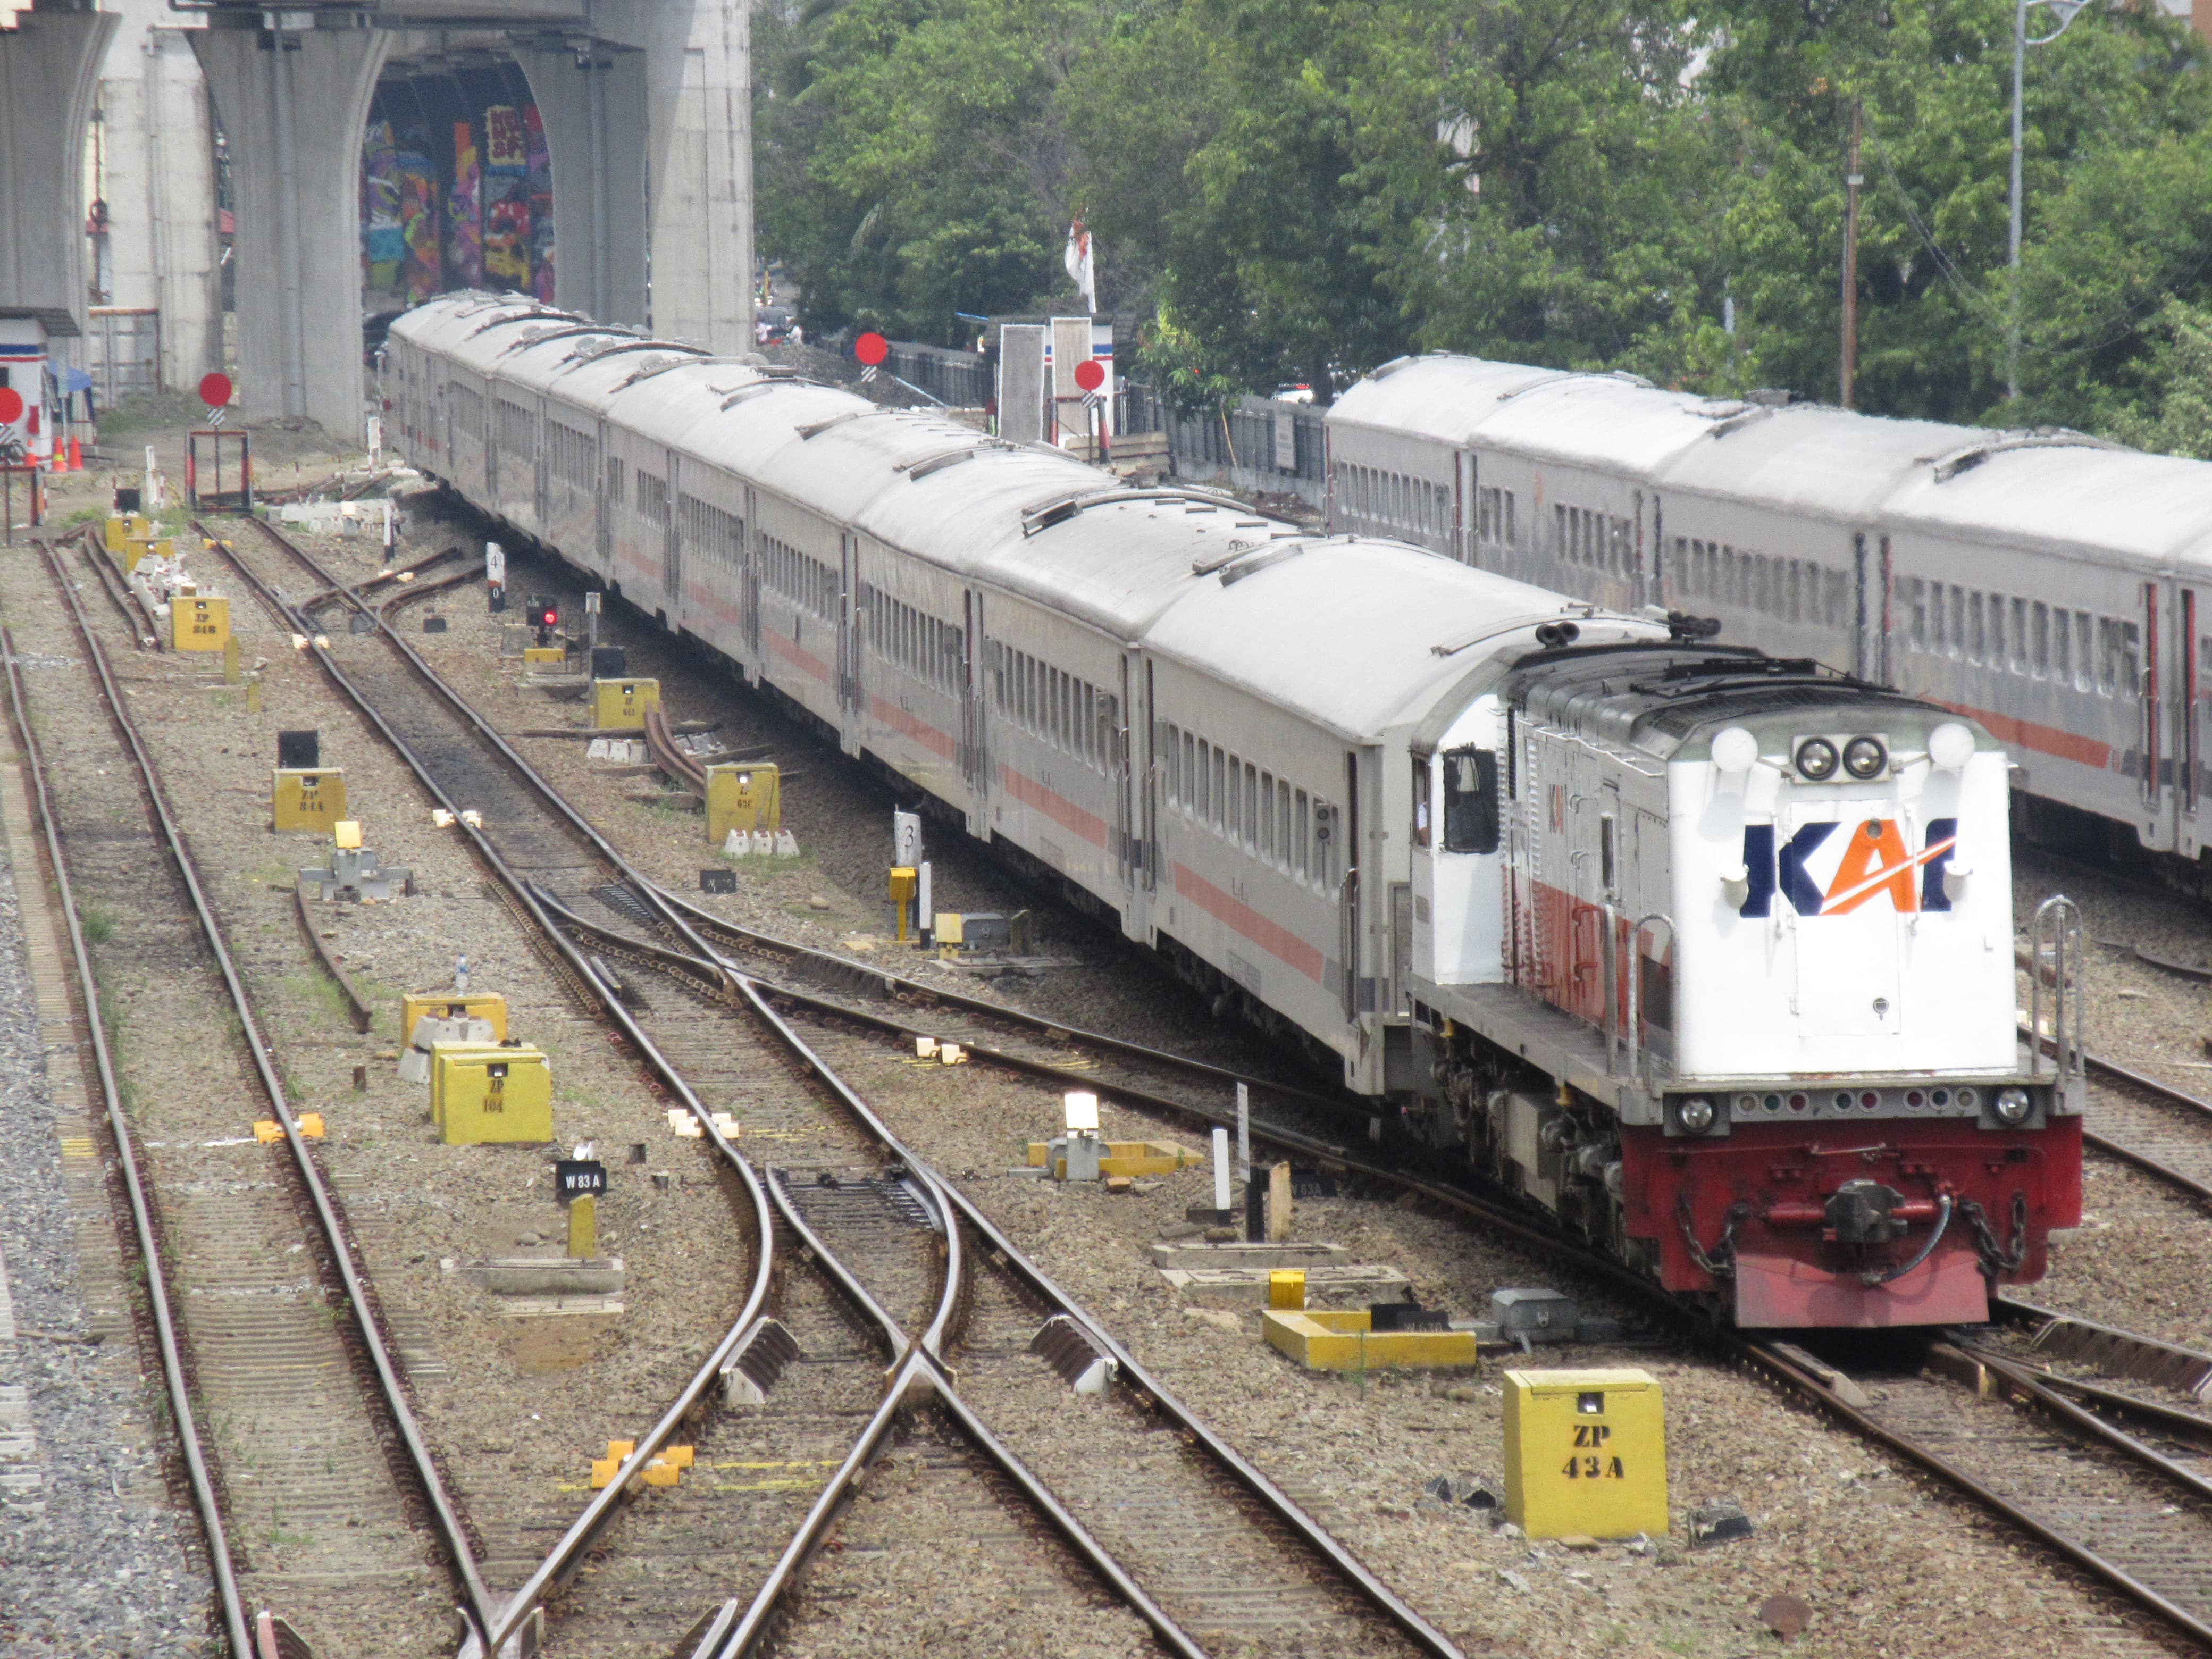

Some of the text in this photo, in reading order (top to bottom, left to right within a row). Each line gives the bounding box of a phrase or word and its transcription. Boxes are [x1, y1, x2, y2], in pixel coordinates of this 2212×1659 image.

[490, 555, 497, 569] 4
[492, 588, 499, 599] 0
[904, 825, 914, 848] 3
[1739, 817, 1957, 918] KAI
[565, 1174, 600, 1189] W 83 A
[1573, 1425, 1611, 1448] ZP
[1561, 1456, 1624, 1479] 43A
